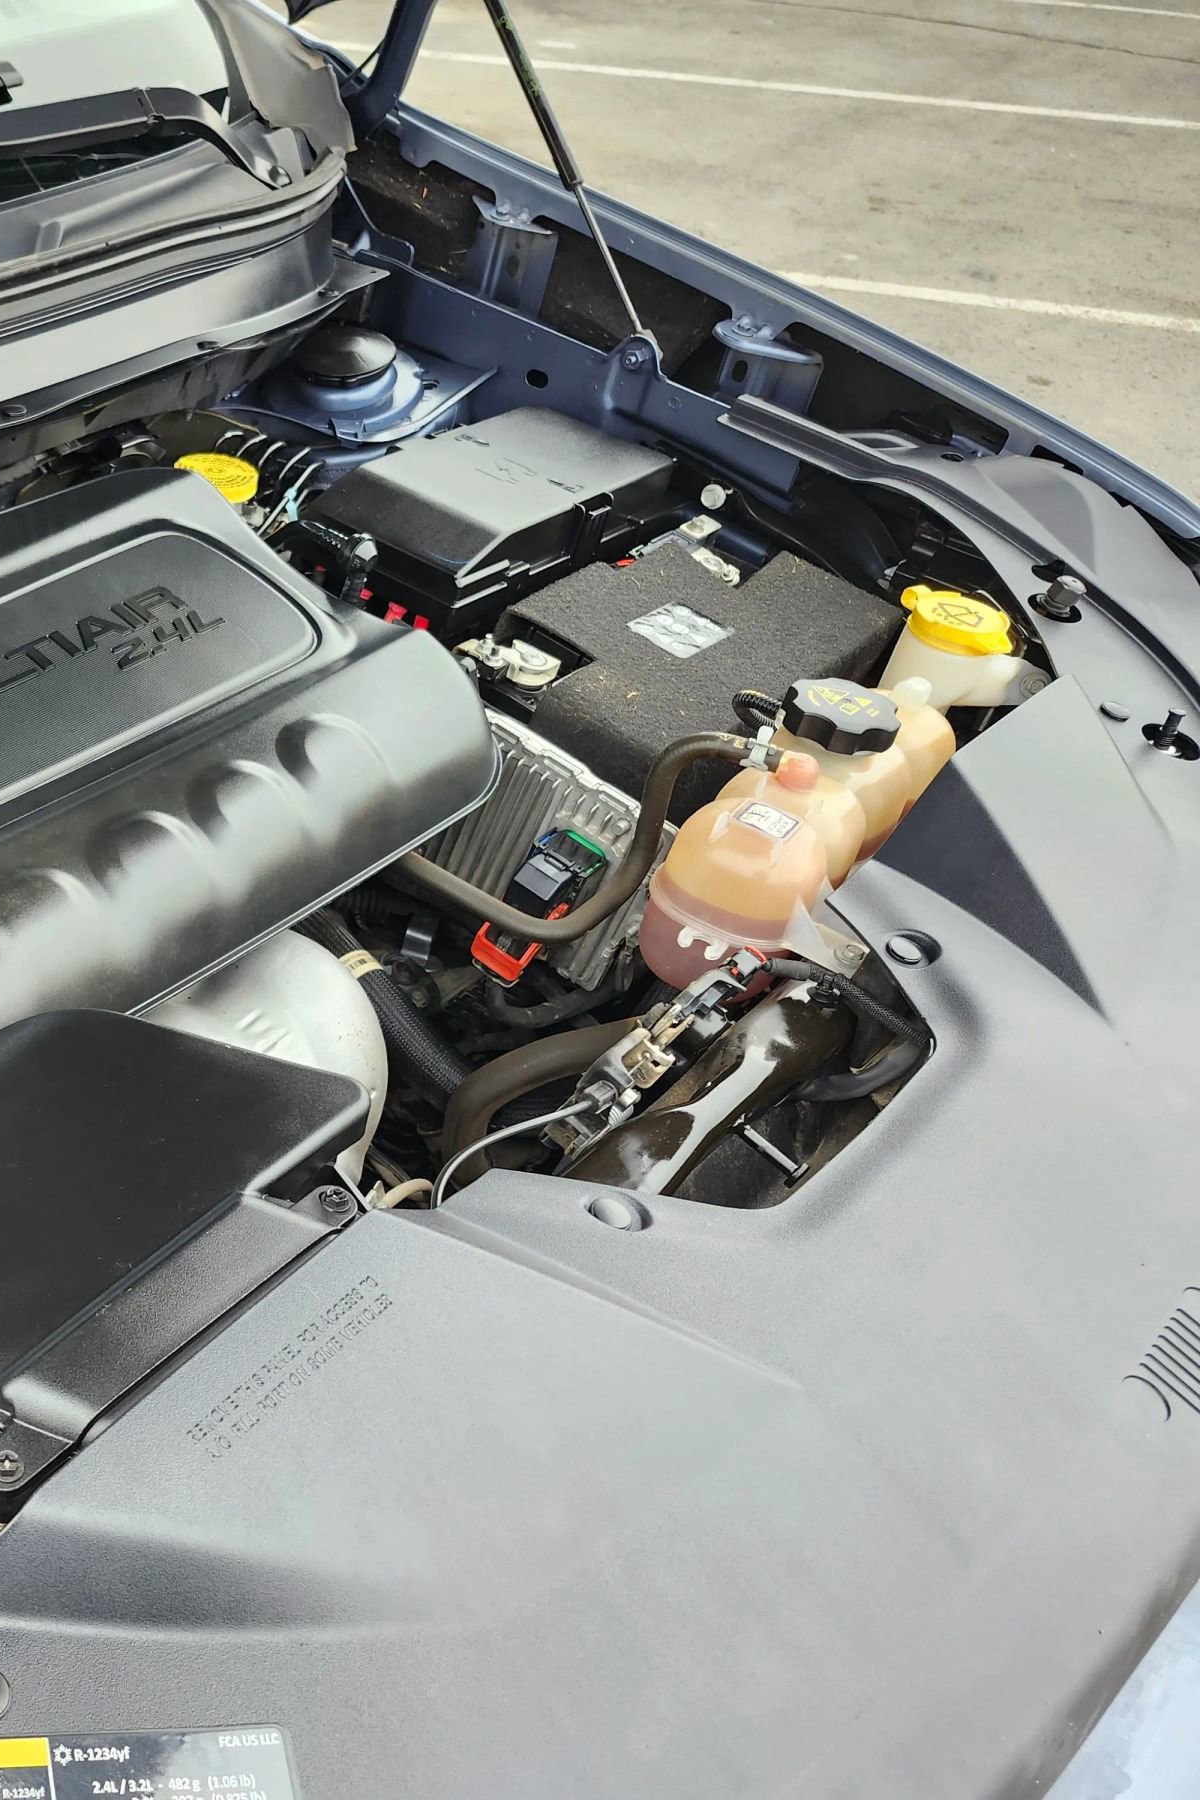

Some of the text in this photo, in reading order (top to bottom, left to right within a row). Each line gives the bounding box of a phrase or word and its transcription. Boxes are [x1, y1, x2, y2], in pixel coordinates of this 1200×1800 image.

[110, 610, 227, 671] 2.4L
[233, 1372, 265, 1404] THIS
[261, 1343, 301, 1380] PANEL
[297, 1322, 325, 1348] FOR
[320, 1288, 364, 1329] ACCESS
[359, 1275, 378, 1292] TO
[231, 1411, 260, 1439] FILL
[256, 1380, 290, 1416] PORT
[289, 1364, 312, 1386] ON
[307, 1335, 343, 1370] SOME
[339, 1293, 393, 1341] VEHICLES
[218, 1733, 281, 1748] FCA US LLC
[73, 1745, 131, 1763] R-1234yf
[2, 1786, 46, 1800] R-1234yf
[92, 1779, 119, 1794] 2.4L
[128, 1778, 154, 1793] 3.2L
[168, 1776, 191, 1791] 482
[192, 1779, 201, 1792] g
[207, 1775, 238, 1791] (1.06
[238, 1773, 256, 1789] lb)
